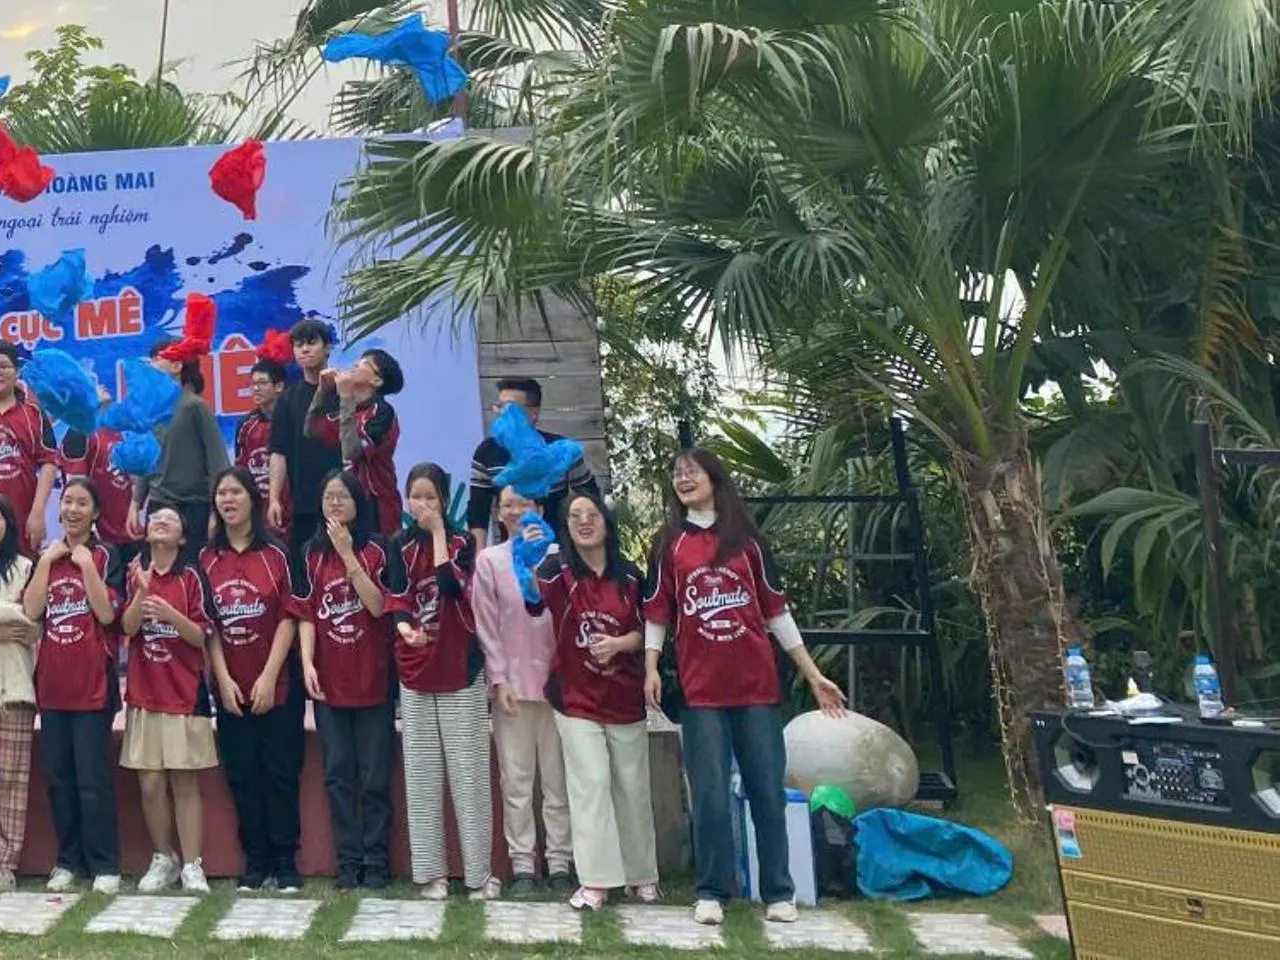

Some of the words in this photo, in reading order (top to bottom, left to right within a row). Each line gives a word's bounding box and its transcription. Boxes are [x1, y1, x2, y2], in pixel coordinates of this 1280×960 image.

[115, 171, 155, 190] MAI
[75, 285, 144, 341] MÊ
[683, 585, 751, 618] Soulmate
